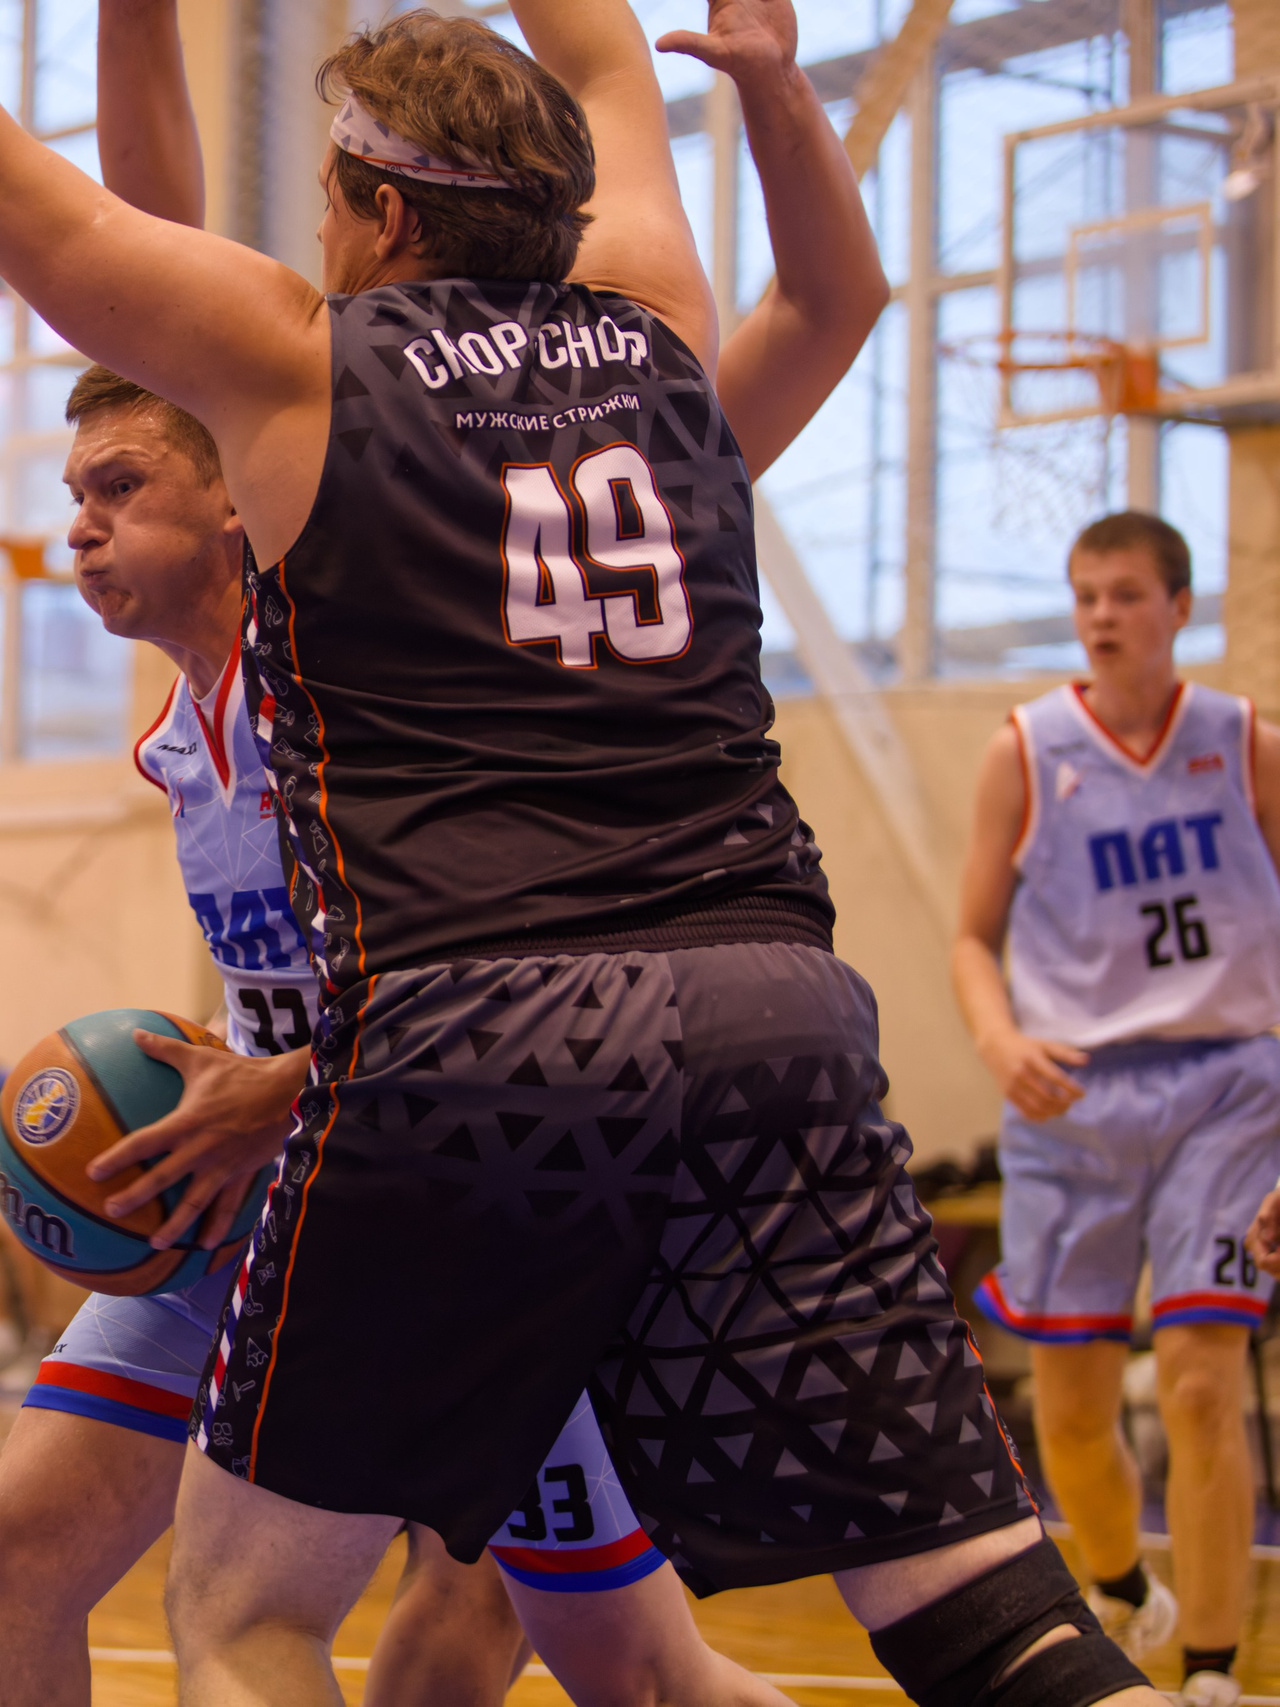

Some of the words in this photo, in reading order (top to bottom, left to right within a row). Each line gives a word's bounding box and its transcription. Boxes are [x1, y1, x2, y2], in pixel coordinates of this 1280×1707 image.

[456, 412, 550, 431] МУЖСКИЕ
[553, 393, 640, 429] СТРИЖКИ
[501, 442, 693, 670] 49
[1088, 811, 1223, 891] ПАТ
[1140, 893, 1211, 968] 26
[506, 1463, 594, 1542] 33
